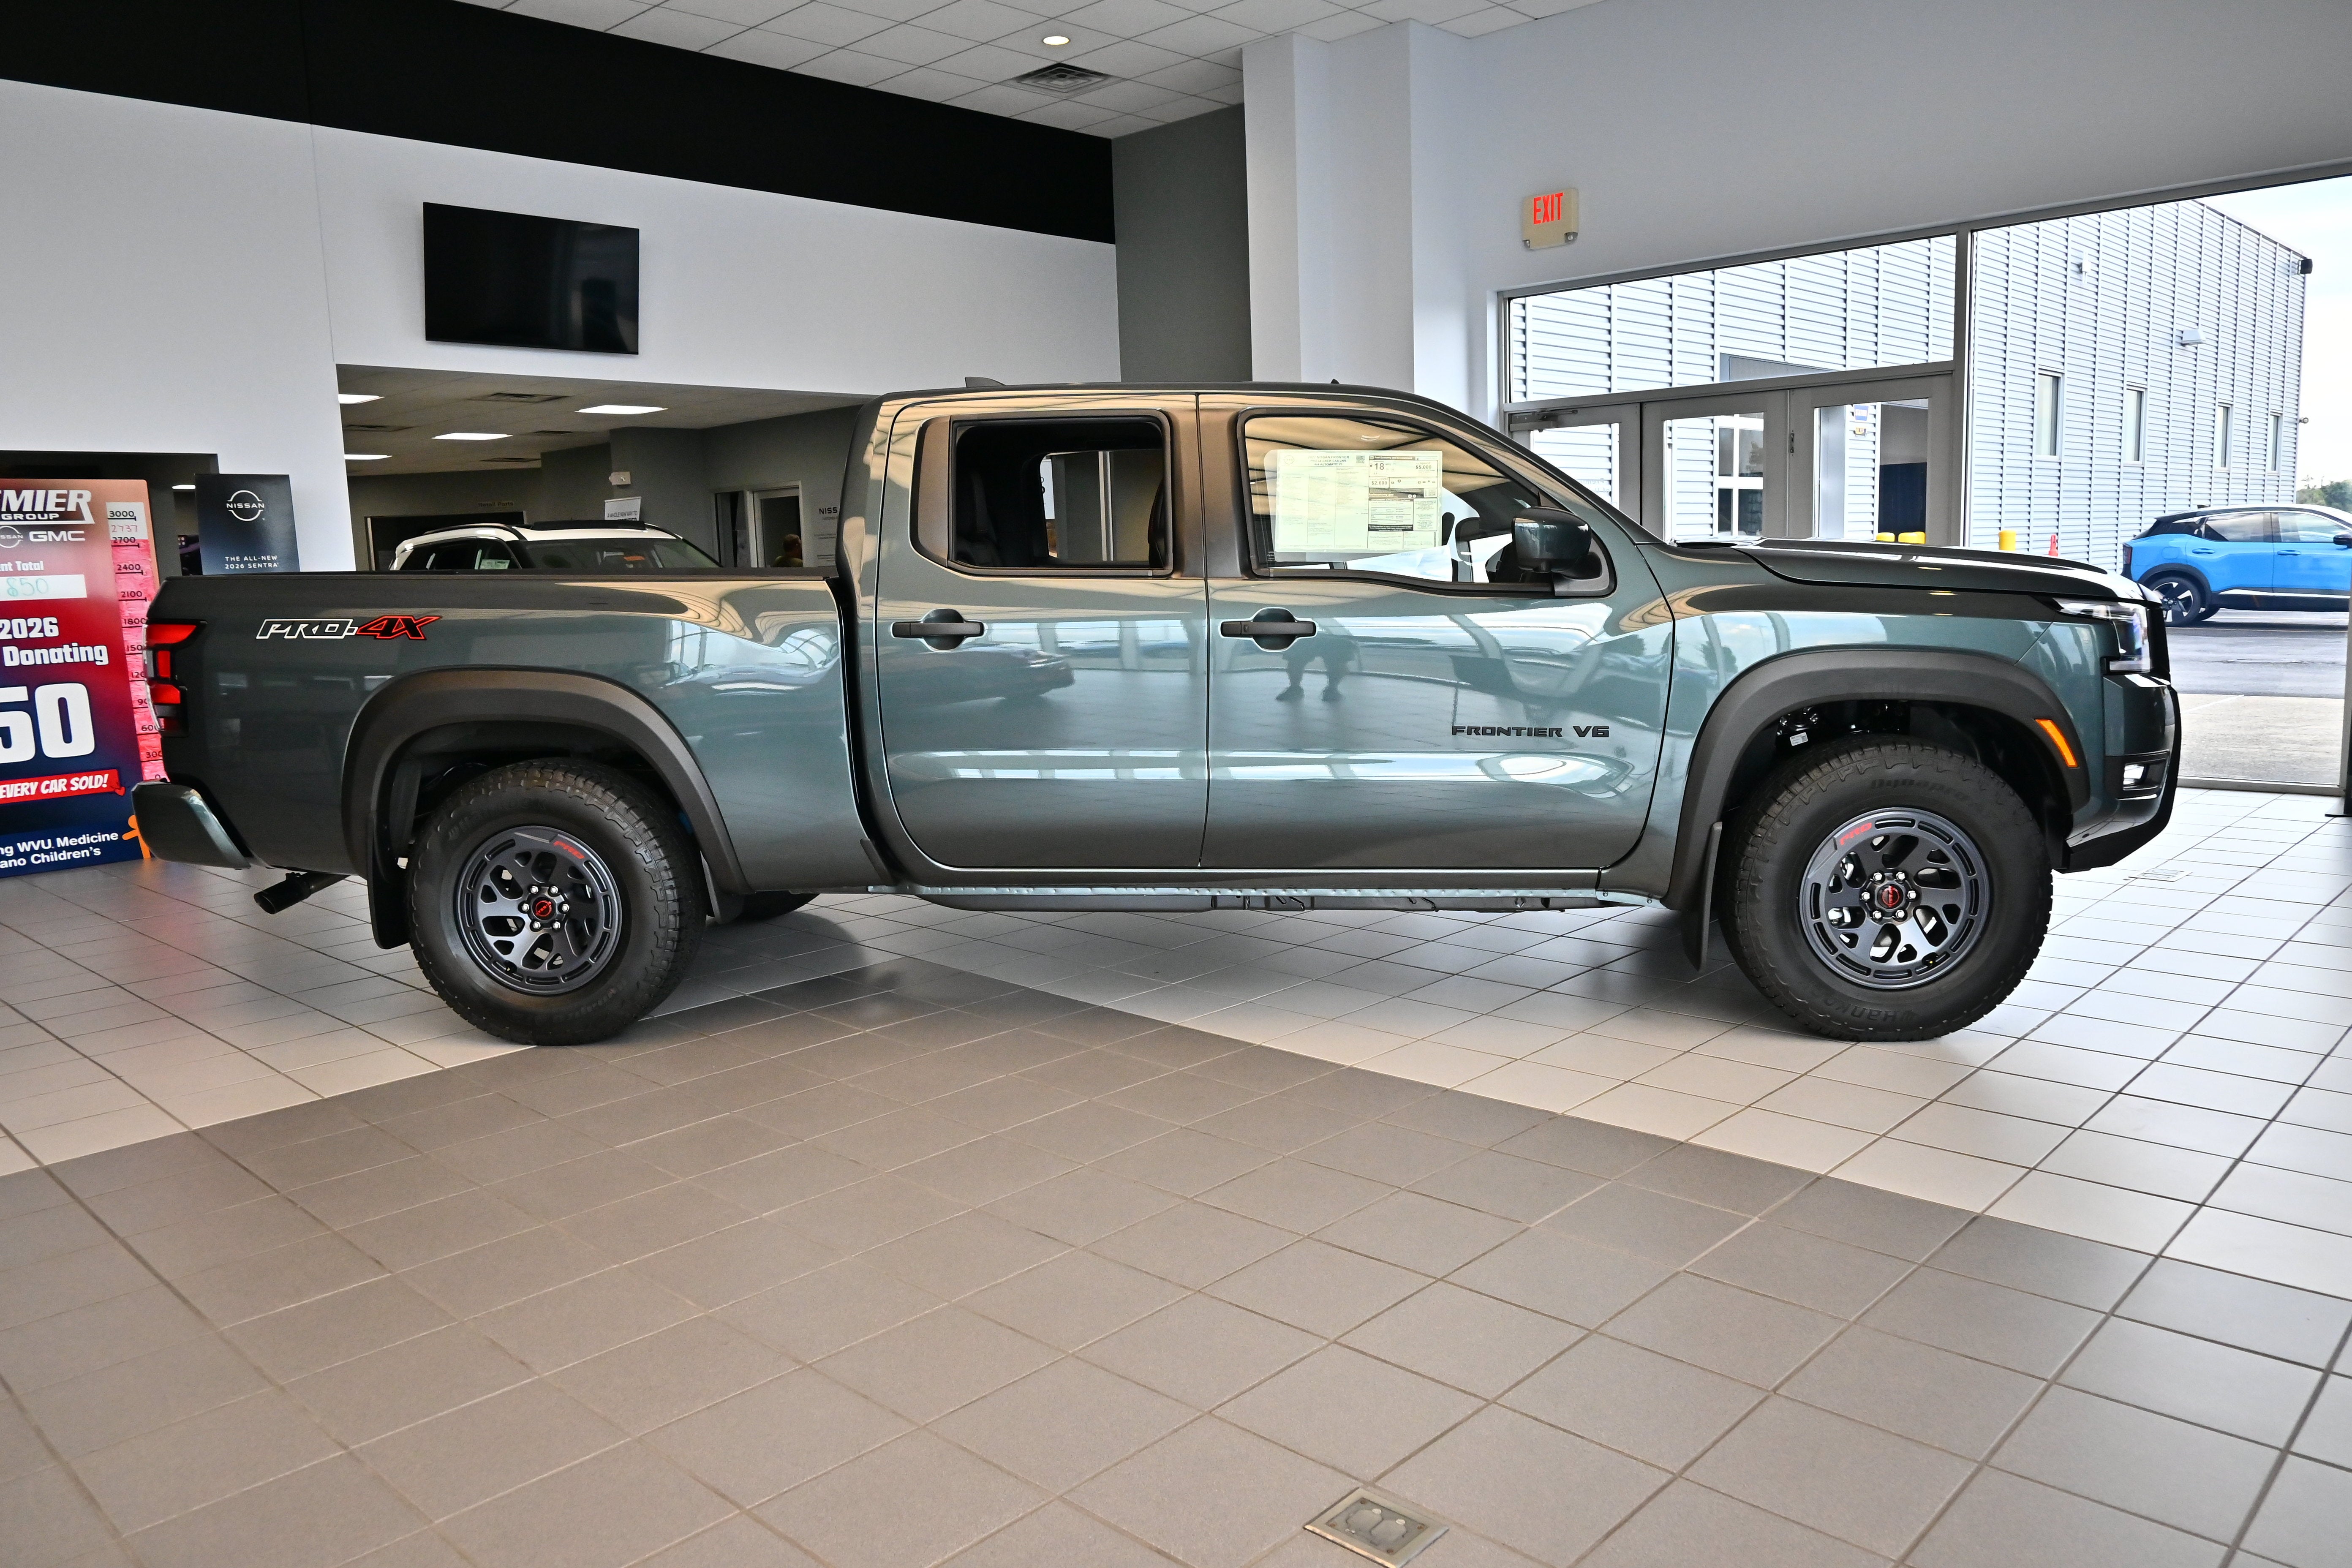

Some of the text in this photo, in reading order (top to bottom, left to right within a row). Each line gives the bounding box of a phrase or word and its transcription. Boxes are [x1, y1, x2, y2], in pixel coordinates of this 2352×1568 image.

[1533, 192, 1564, 224] EXIT
[0, 490, 92, 512] MIER
[29, 530, 86, 542] GMC
[112, 524, 138, 533] 2737
[0, 561, 44, 572] nt Total
[0, 617, 60, 640] 2026
[2, 642, 109, 667] Donating
[1452, 726, 1609, 738] FRONTIER V6
[0, 773, 109, 798] EVERY CAR SOLD!
[0, 832, 119, 857] ng WVU Medicine
[0, 847, 101, 869] ano Children's
